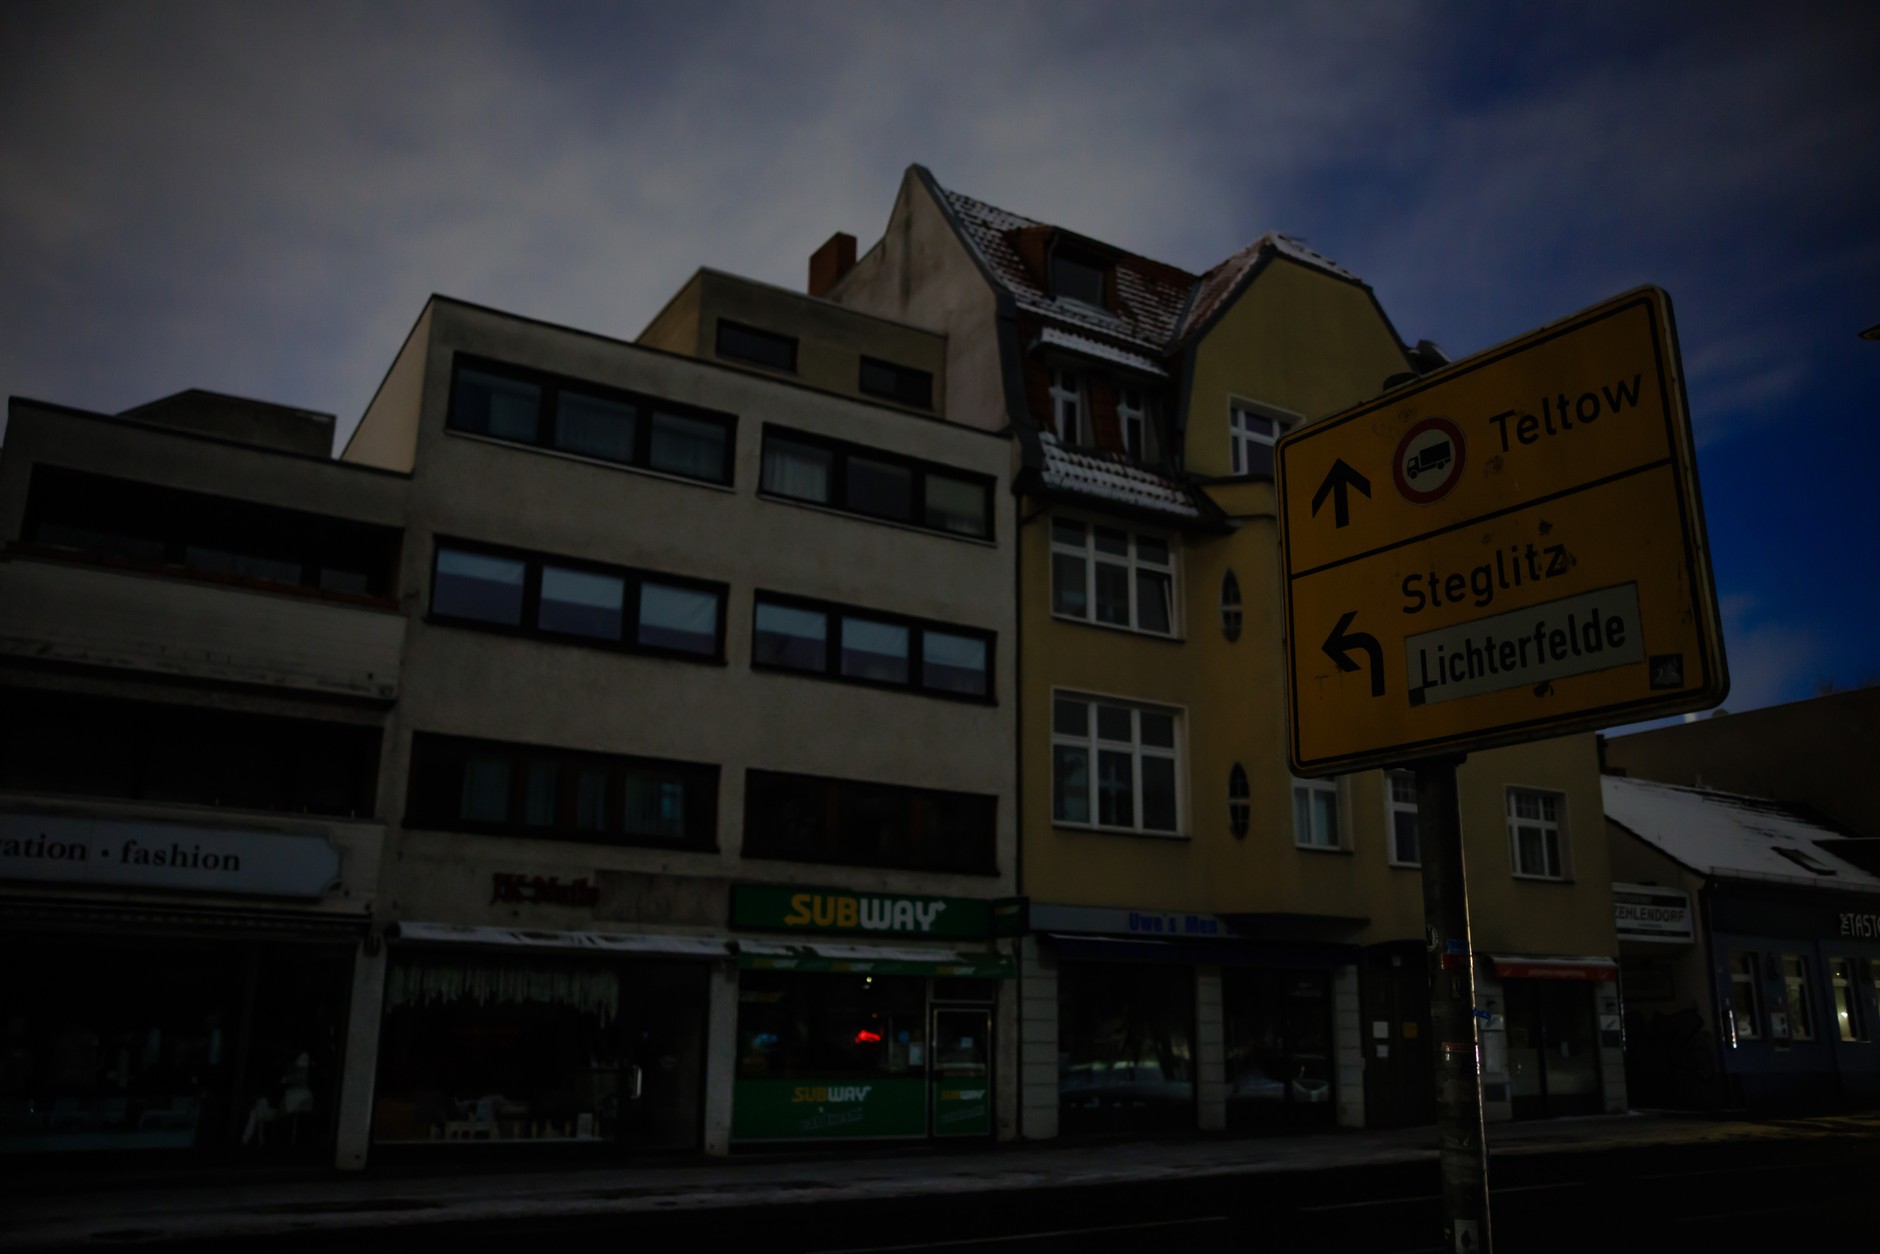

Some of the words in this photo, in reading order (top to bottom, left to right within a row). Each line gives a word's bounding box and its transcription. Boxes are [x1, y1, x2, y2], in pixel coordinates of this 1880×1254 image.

[1489, 374, 1642, 453] Teltow
[1402, 543, 1567, 615] Steglitz
[1419, 608, 1626, 690] Lichterfelde
[0, 833, 87, 861] ation
[119, 839, 241, 872] fashion
[784, 891, 948, 932] SUBWAY
[792, 1084, 873, 1103] SUBWAY
